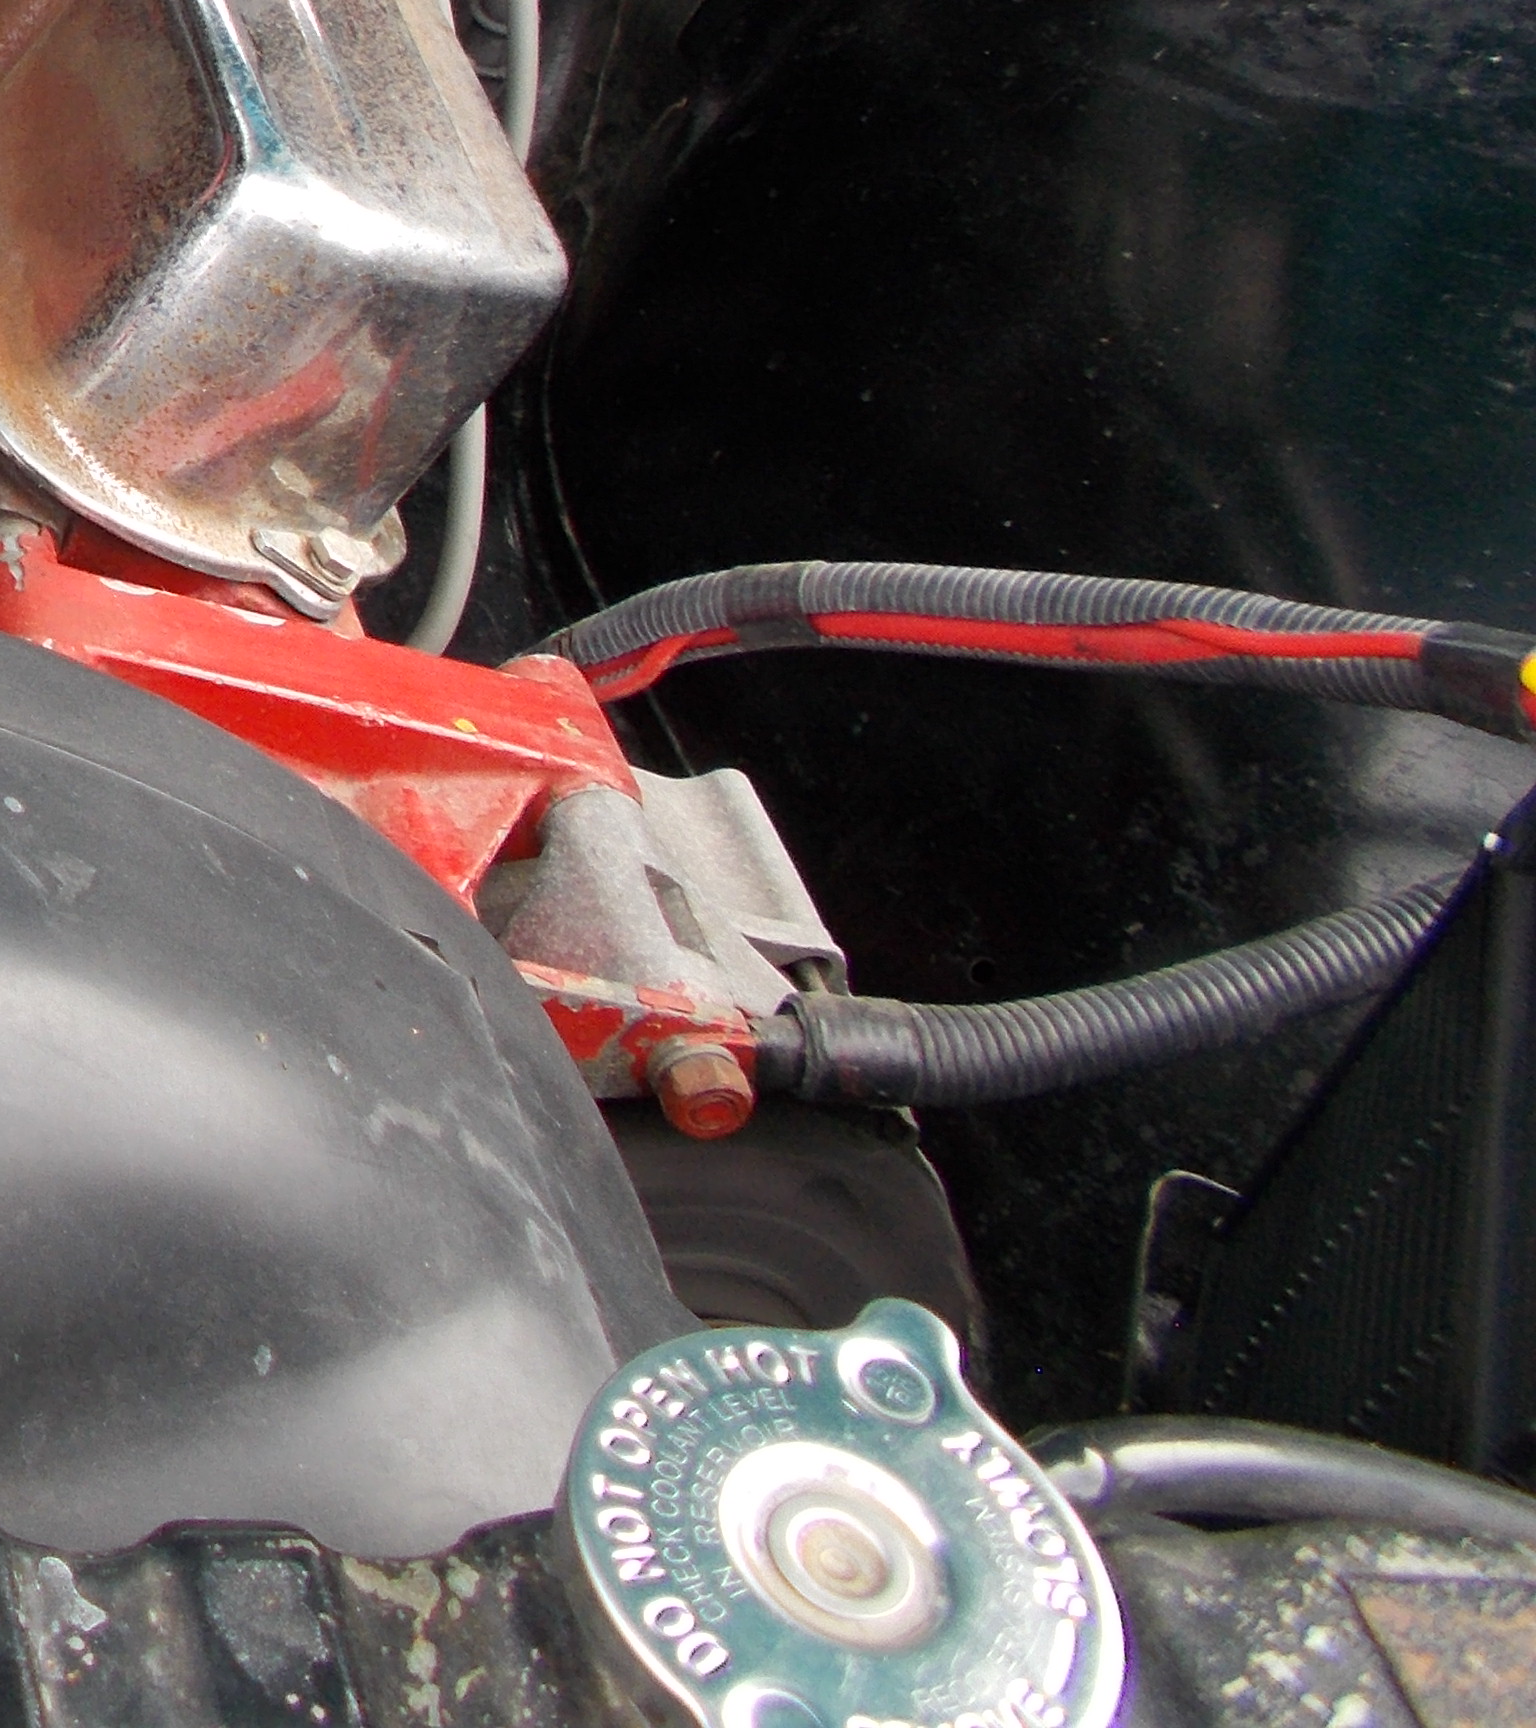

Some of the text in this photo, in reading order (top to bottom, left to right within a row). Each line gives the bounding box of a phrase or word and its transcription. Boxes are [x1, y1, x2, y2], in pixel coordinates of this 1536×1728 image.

[593, 1341, 820, 1676] DO NOT OPEN HOT
[650, 1386, 796, 1623] CHECK COOLANT LEVEL
[693, 1418, 800, 1600] IN RESERVOIR
